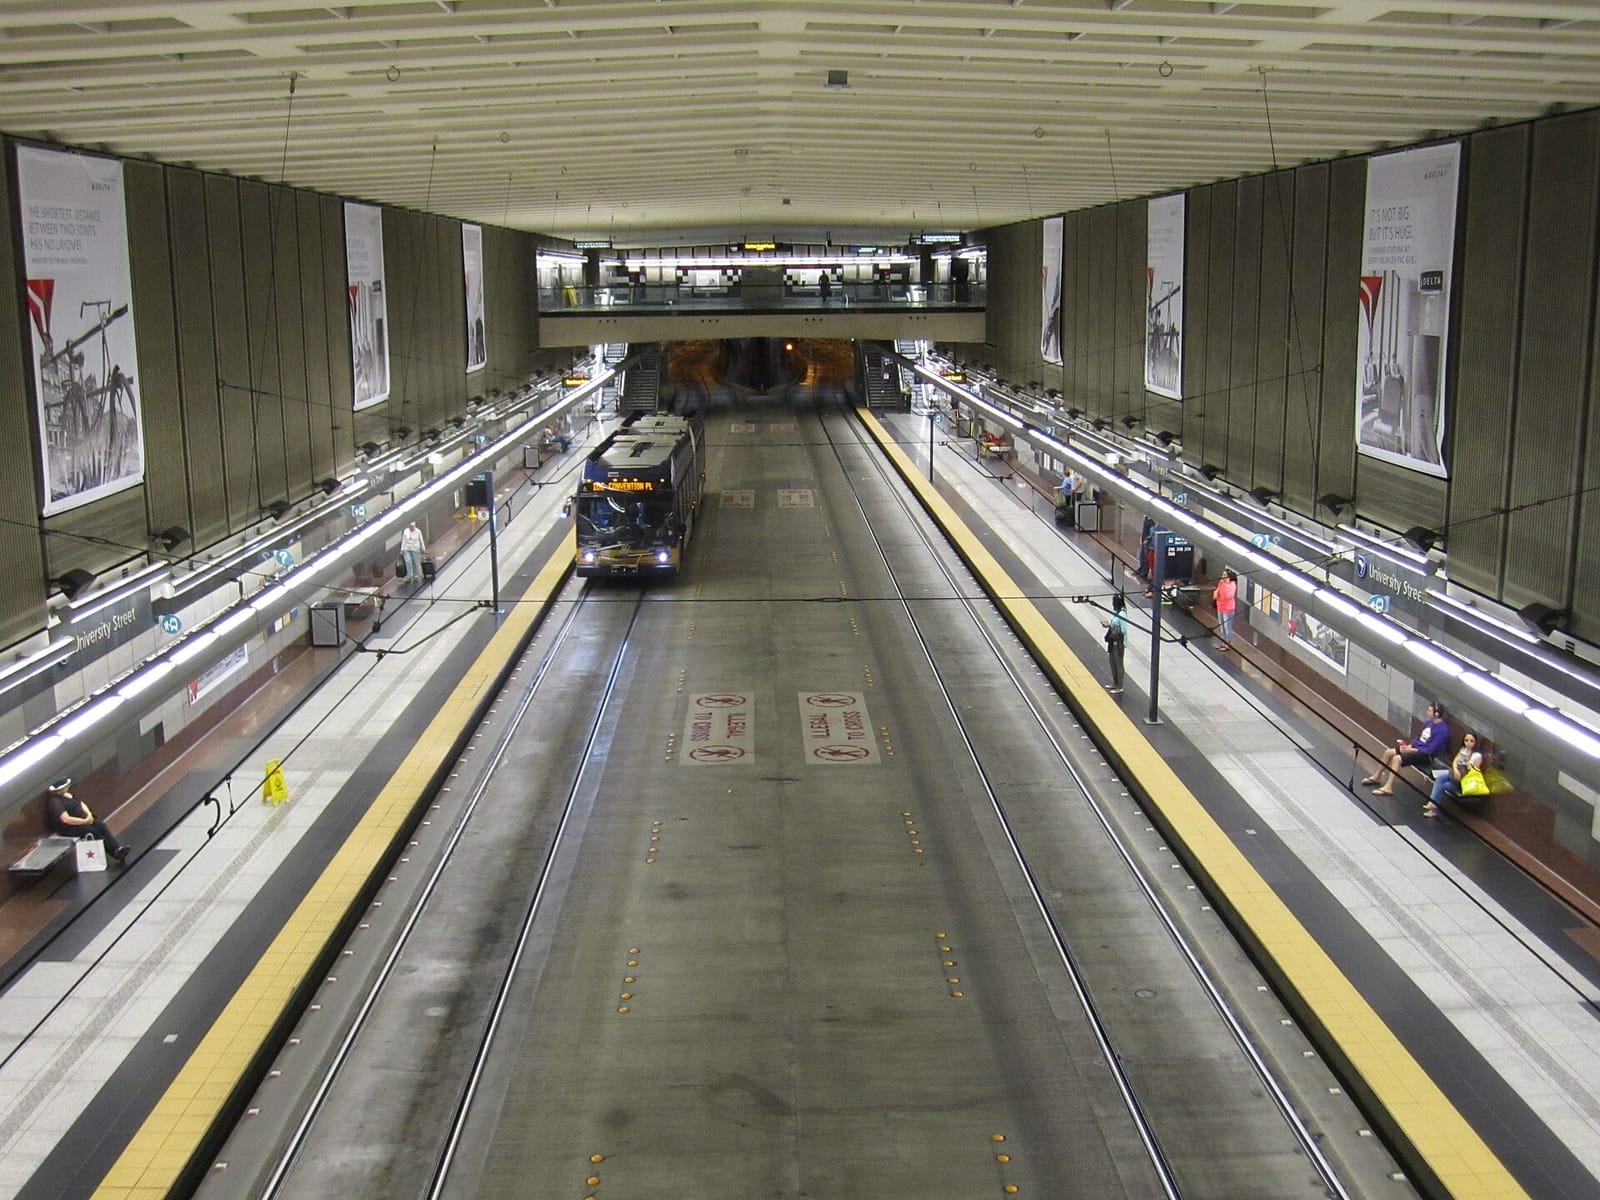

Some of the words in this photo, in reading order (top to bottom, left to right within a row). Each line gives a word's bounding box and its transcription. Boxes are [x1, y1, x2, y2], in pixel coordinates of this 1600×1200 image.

[1382, 207, 1396, 221] NOT
[1398, 206, 1410, 220] BIG
[1422, 276, 1441, 286] DELTA
[645, 482, 654, 491] PL
[1369, 564, 1402, 595] University
[1403, 581, 1423, 603] Stree
[112, 607, 136, 631] Street
[694, 712, 712, 720] TO
[727, 713, 747, 738] ILLEGAL
[808, 713, 830, 739] ILLEGAL
[848, 731, 867, 740] TO
